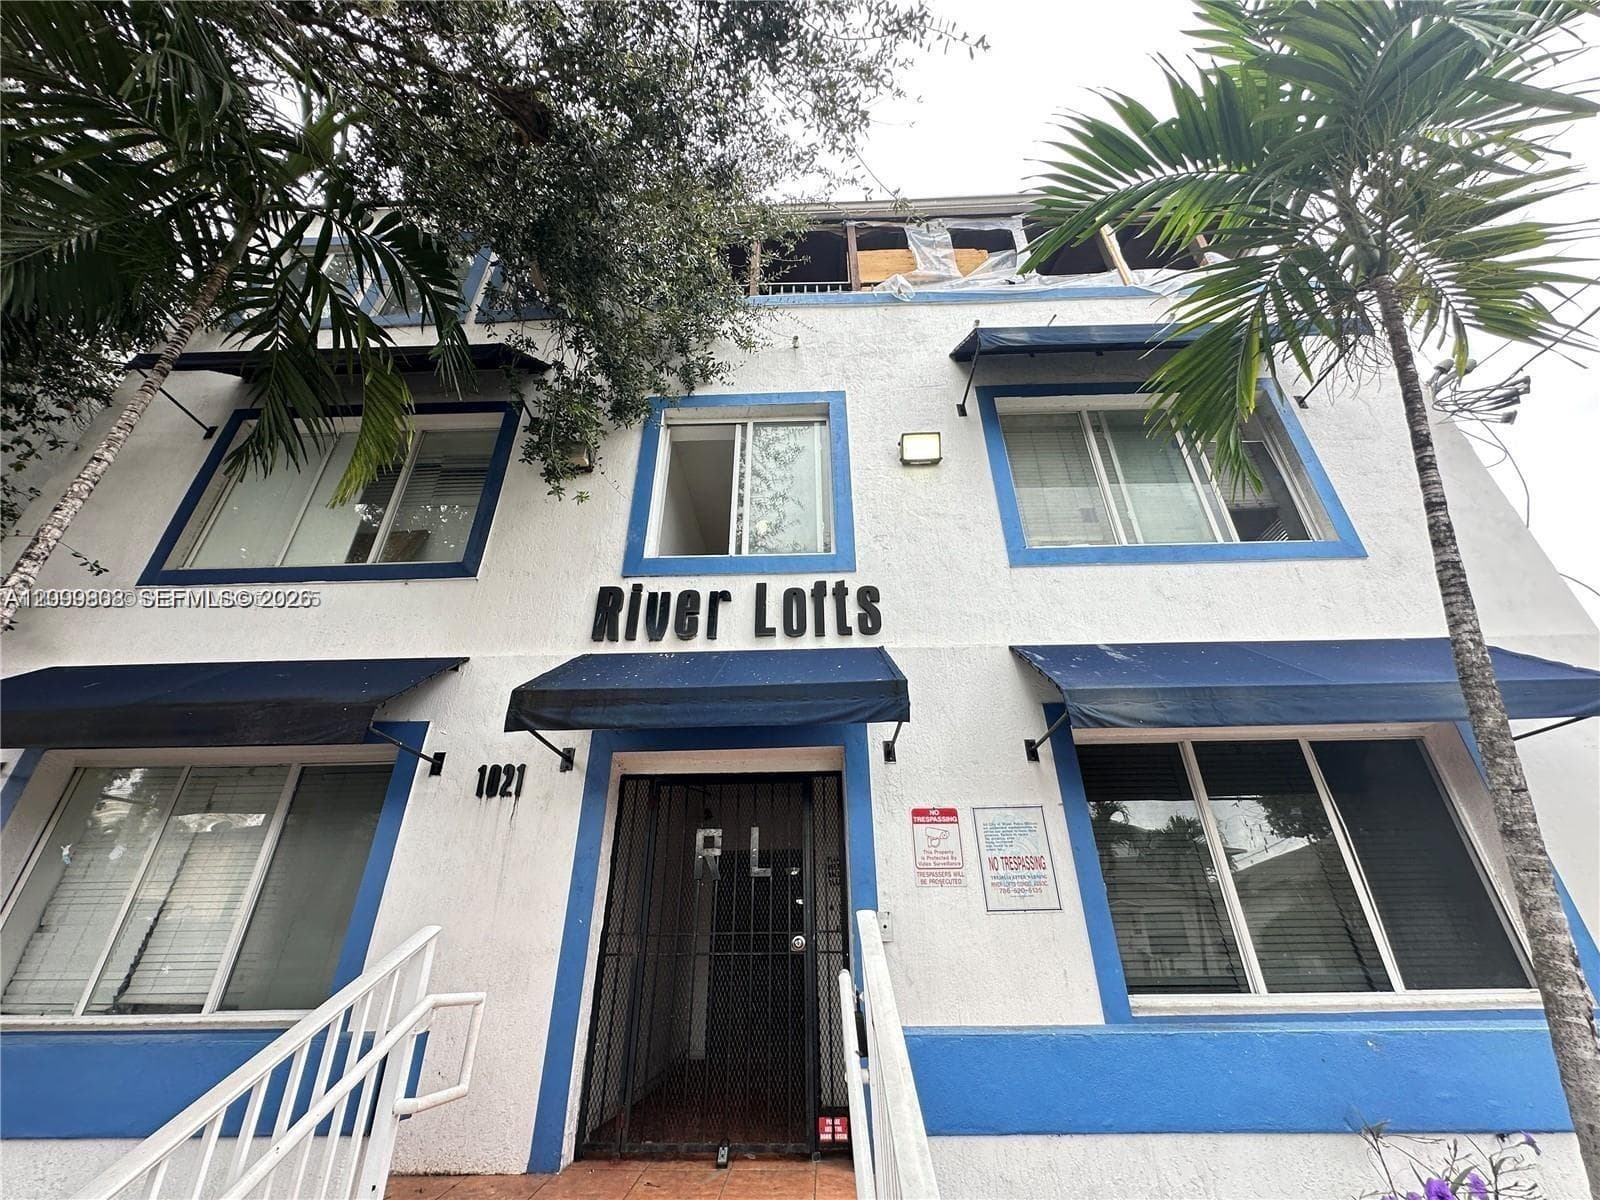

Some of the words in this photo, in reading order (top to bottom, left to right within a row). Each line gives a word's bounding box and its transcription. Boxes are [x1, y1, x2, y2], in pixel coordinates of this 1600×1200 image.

[592, 583, 732, 643] River
[754, 579, 882, 638] Lofts
[475, 763, 526, 799] 1021
[693, 827, 723, 881] R
[750, 826, 772, 877] L
[988, 856, 999, 871] NO
[1000, 855, 1047, 871] TRESPASSING
